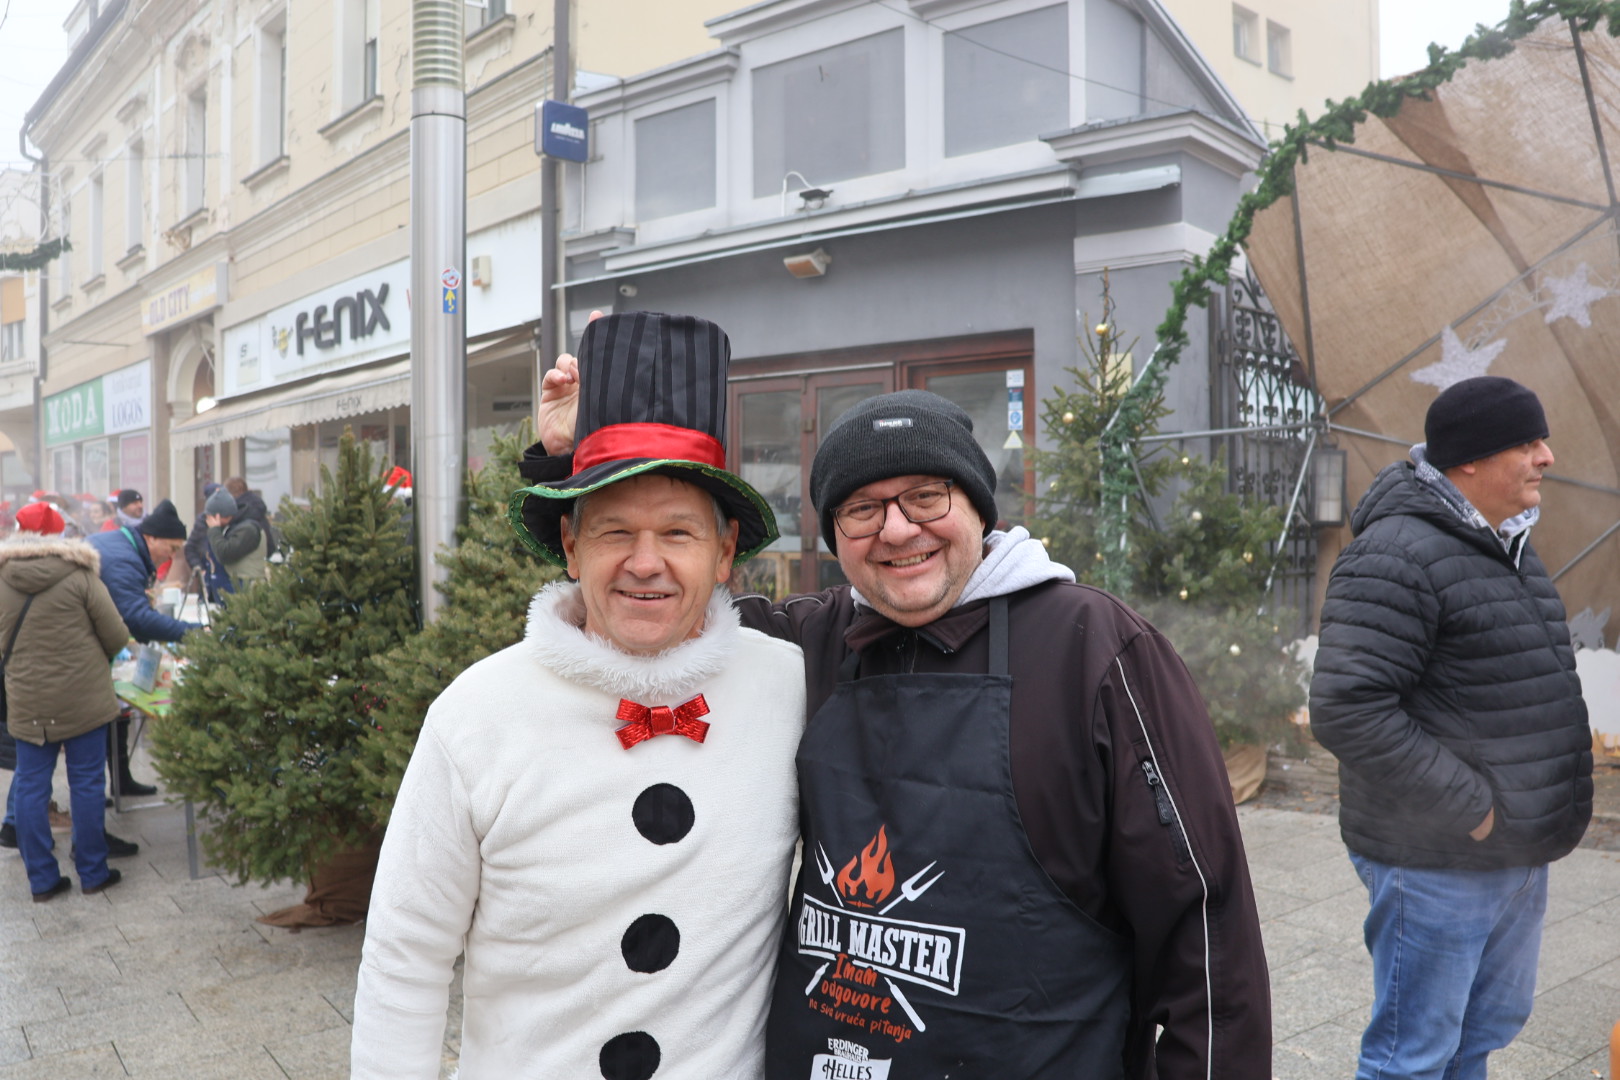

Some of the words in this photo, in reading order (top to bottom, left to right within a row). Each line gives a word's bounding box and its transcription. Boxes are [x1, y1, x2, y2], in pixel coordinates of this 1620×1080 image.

[168, 283, 190, 317] CITY
[296, 282, 391, 356] FENIX
[47, 387, 98, 435] MODA
[112, 397, 143, 428] LOGOS
[800, 903, 842, 952] GRILL
[848, 919, 952, 983] MASTER
[832, 953, 878, 988] Imam
[821, 980, 892, 1014] odgovore
[834, 1010, 866, 1028] vruća
[827, 1037, 870, 1061] ERDINGER
[822, 1058, 873, 1080] HELLES
